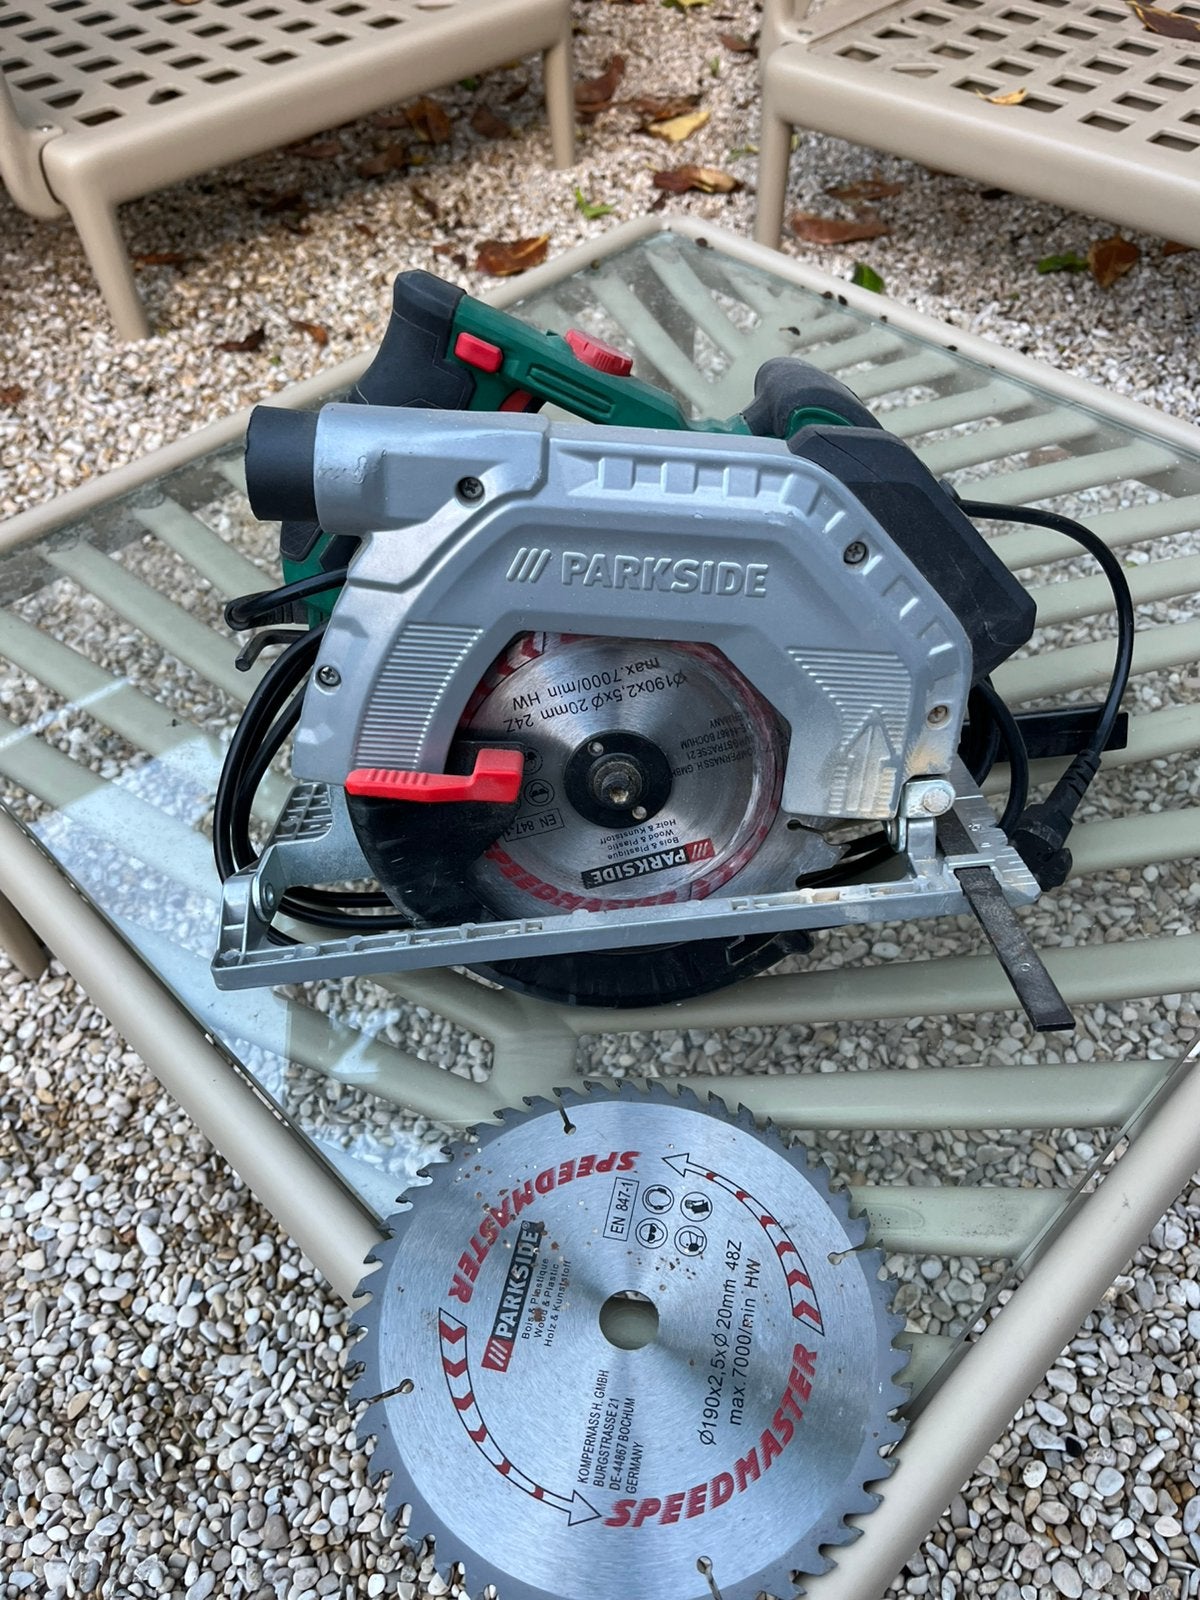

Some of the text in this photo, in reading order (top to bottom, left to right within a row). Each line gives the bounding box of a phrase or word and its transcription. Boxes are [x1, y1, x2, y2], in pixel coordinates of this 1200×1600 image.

[561, 551, 769, 598] PARKSIDE
[512, 691, 541, 711] HW
[503, 714, 534, 733] 24Z
[680, 732, 715, 749] BOCHUM
[686, 749, 696, 760] 21
[539, 813, 557, 828] EN
[600, 826, 646, 846] Kunststoff
[656, 819, 677, 830] Holz
[607, 846, 650, 860] Plastique
[608, 829, 674, 851] Wood & Plastic
[660, 836, 680, 847] Bois
[590, 848, 686, 884] PARKSIDE
[610, 1181, 634, 1234] EN 847-1
[448, 1150, 641, 1304] SPEEDMASTER
[725, 1239, 742, 1271] 48Z
[544, 1263, 559, 1298] Plastic
[744, 1258, 761, 1289] HW
[521, 1317, 534, 1340] Bois
[530, 1258, 549, 1305] Plastique
[541, 1300, 550, 1308] &
[543, 1259, 571, 1347] Holz & Kunststoff
[577, 1411, 601, 1484] KOMPERNASS
[593, 1369, 609, 1399] GMBH
[601, 1343, 817, 1528] SPEEDMASTER
[593, 1398, 620, 1488] BURGSTRASSE 21
[609, 1397, 636, 1491] DE-44867 BOCHUM
[625, 1441, 644, 1494] GERMANY
